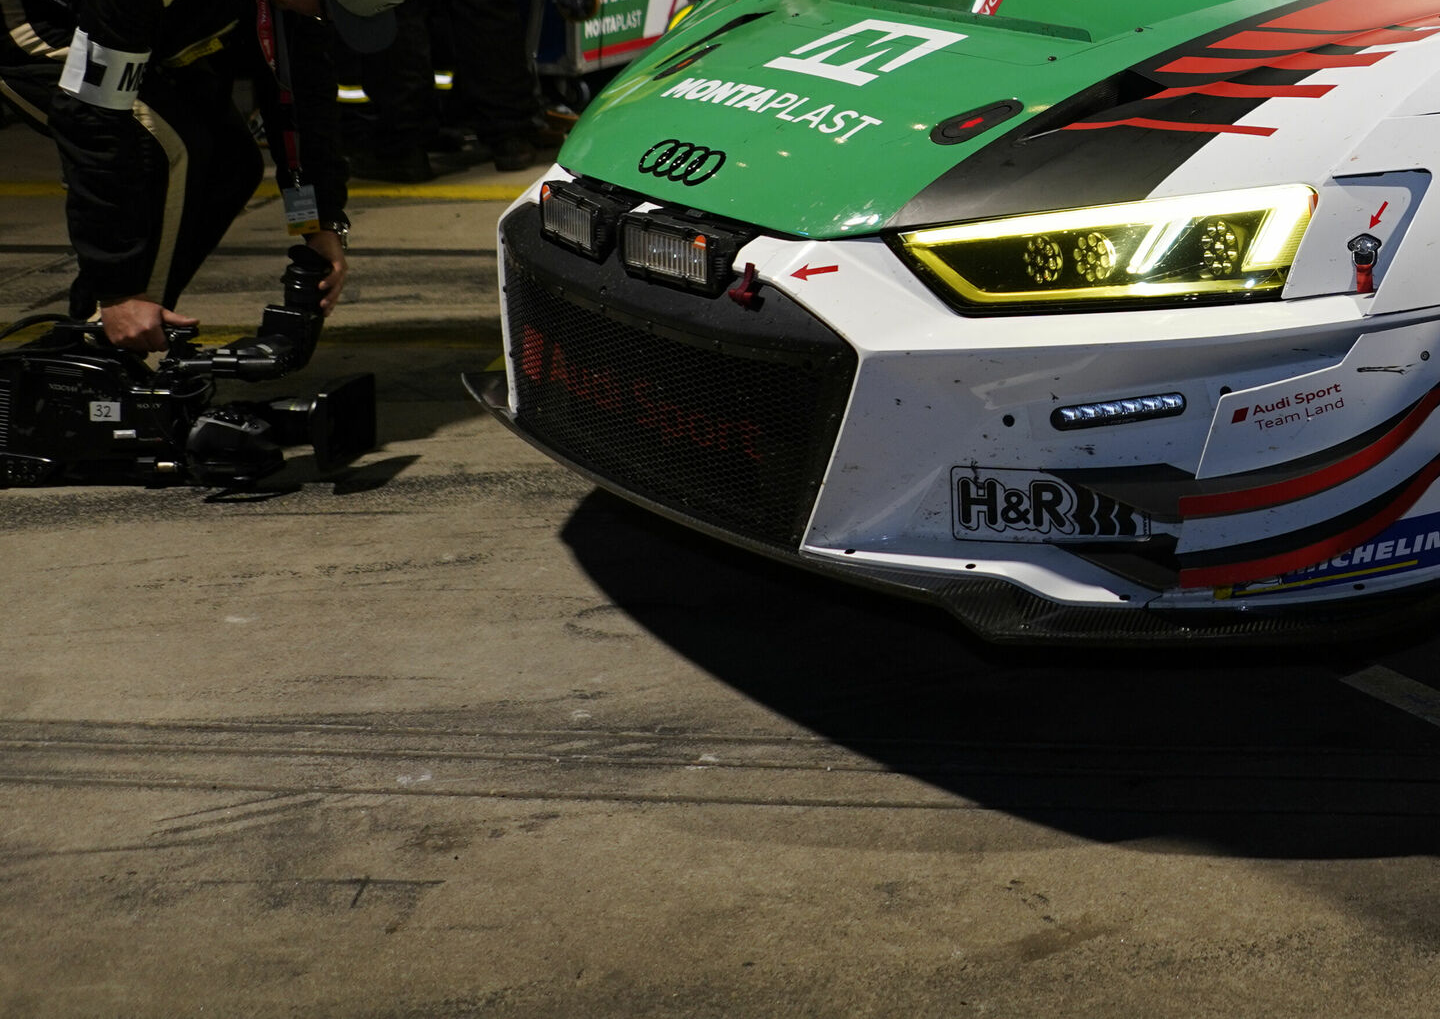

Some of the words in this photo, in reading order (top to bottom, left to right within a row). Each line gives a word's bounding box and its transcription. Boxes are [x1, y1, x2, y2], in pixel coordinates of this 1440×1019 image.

[660, 77, 883, 140] MONTAPLAST
[94, 404, 112, 418] 32
[1253, 396, 1290, 416] Audi
[1295, 383, 1342, 404] Sport
[1255, 413, 1301, 431] Team
[1306, 397, 1345, 418] Land
[957, 478, 1067, 530] H&R
